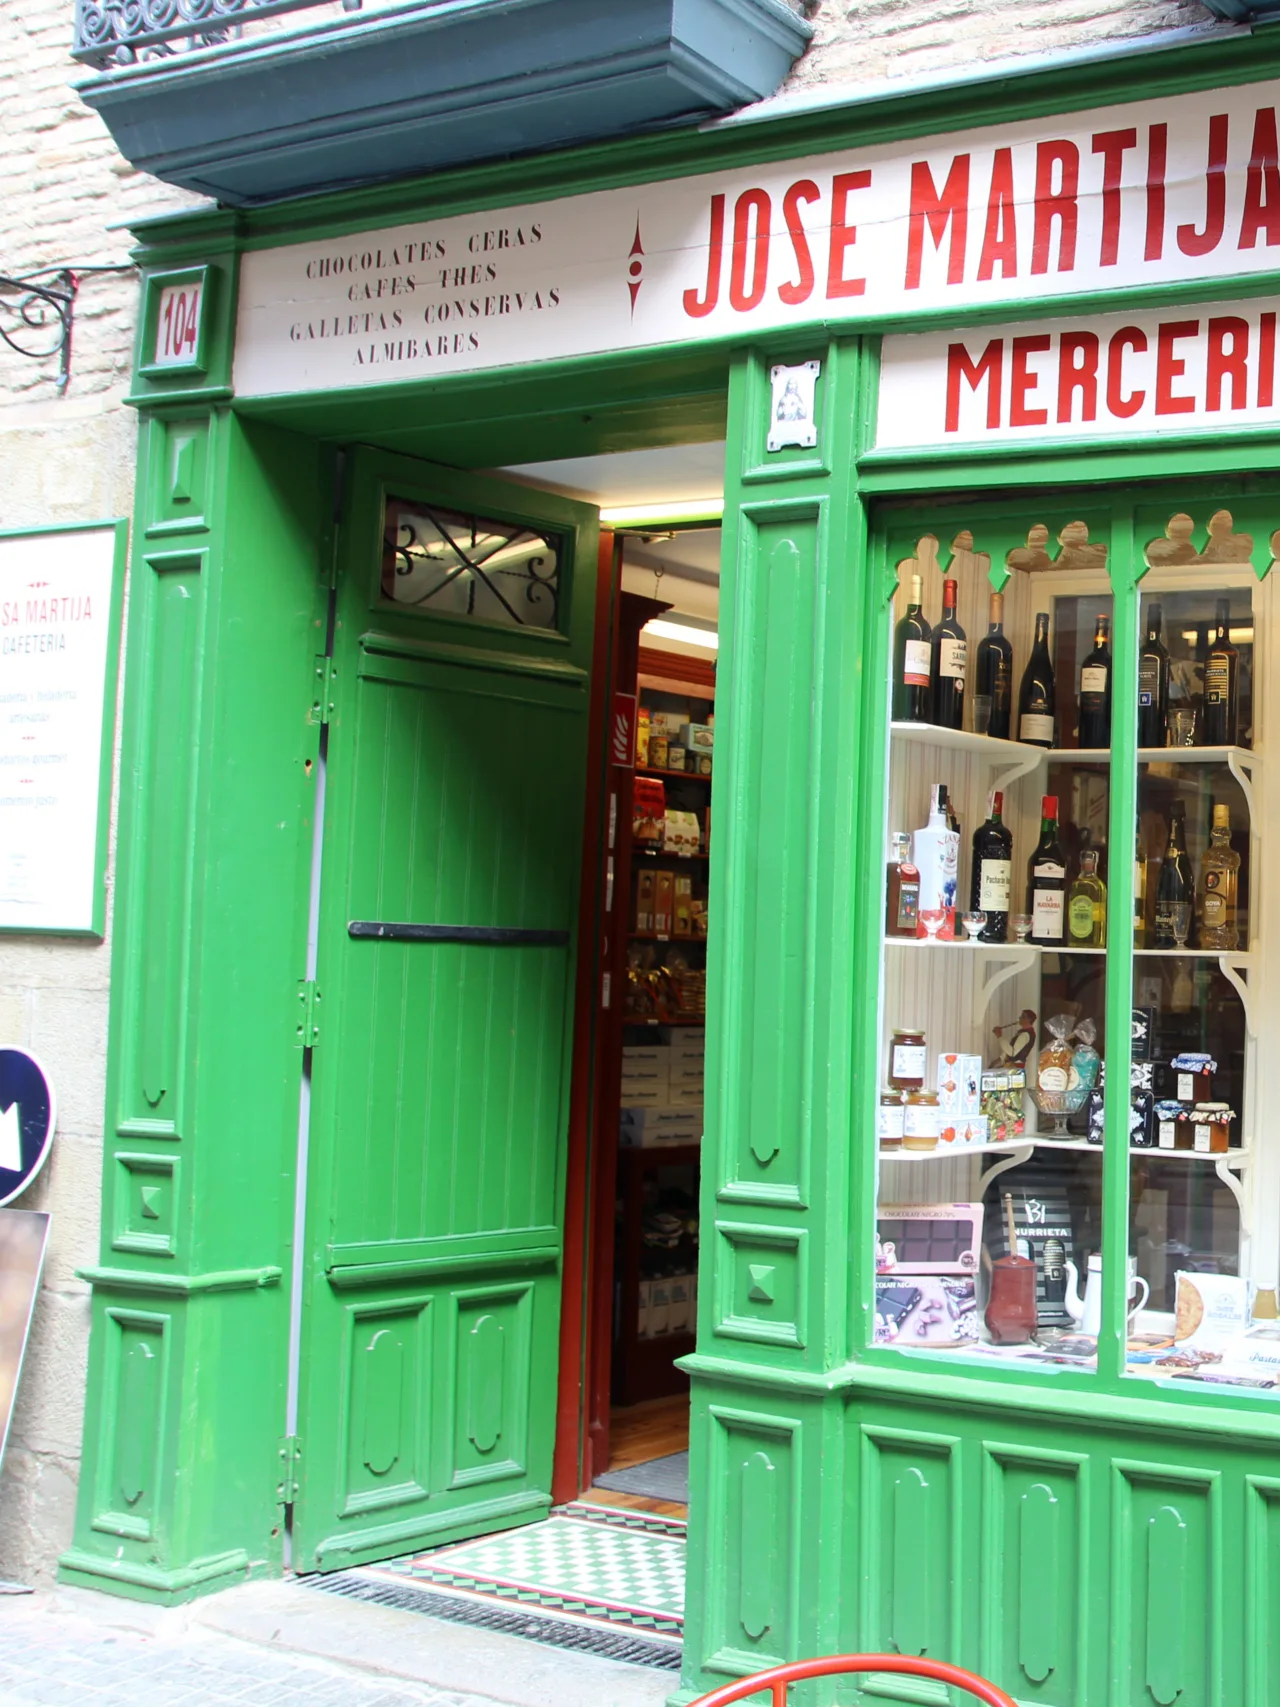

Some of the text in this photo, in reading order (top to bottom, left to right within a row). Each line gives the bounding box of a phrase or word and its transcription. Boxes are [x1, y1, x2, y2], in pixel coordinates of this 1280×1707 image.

[306, 223, 542, 279] CHOCOLATES CERAS
[682, 170, 872, 318] JOSE
[348, 263, 496, 301] CAFES THES
[164, 290, 198, 356] 104
[290, 288, 560, 341] GALLETAS CONSERVAS
[352, 331, 480, 365] ALMIBARES
[25, 595, 92, 627] MARTIJA
[3, 632, 66, 655] CAFETERIA
